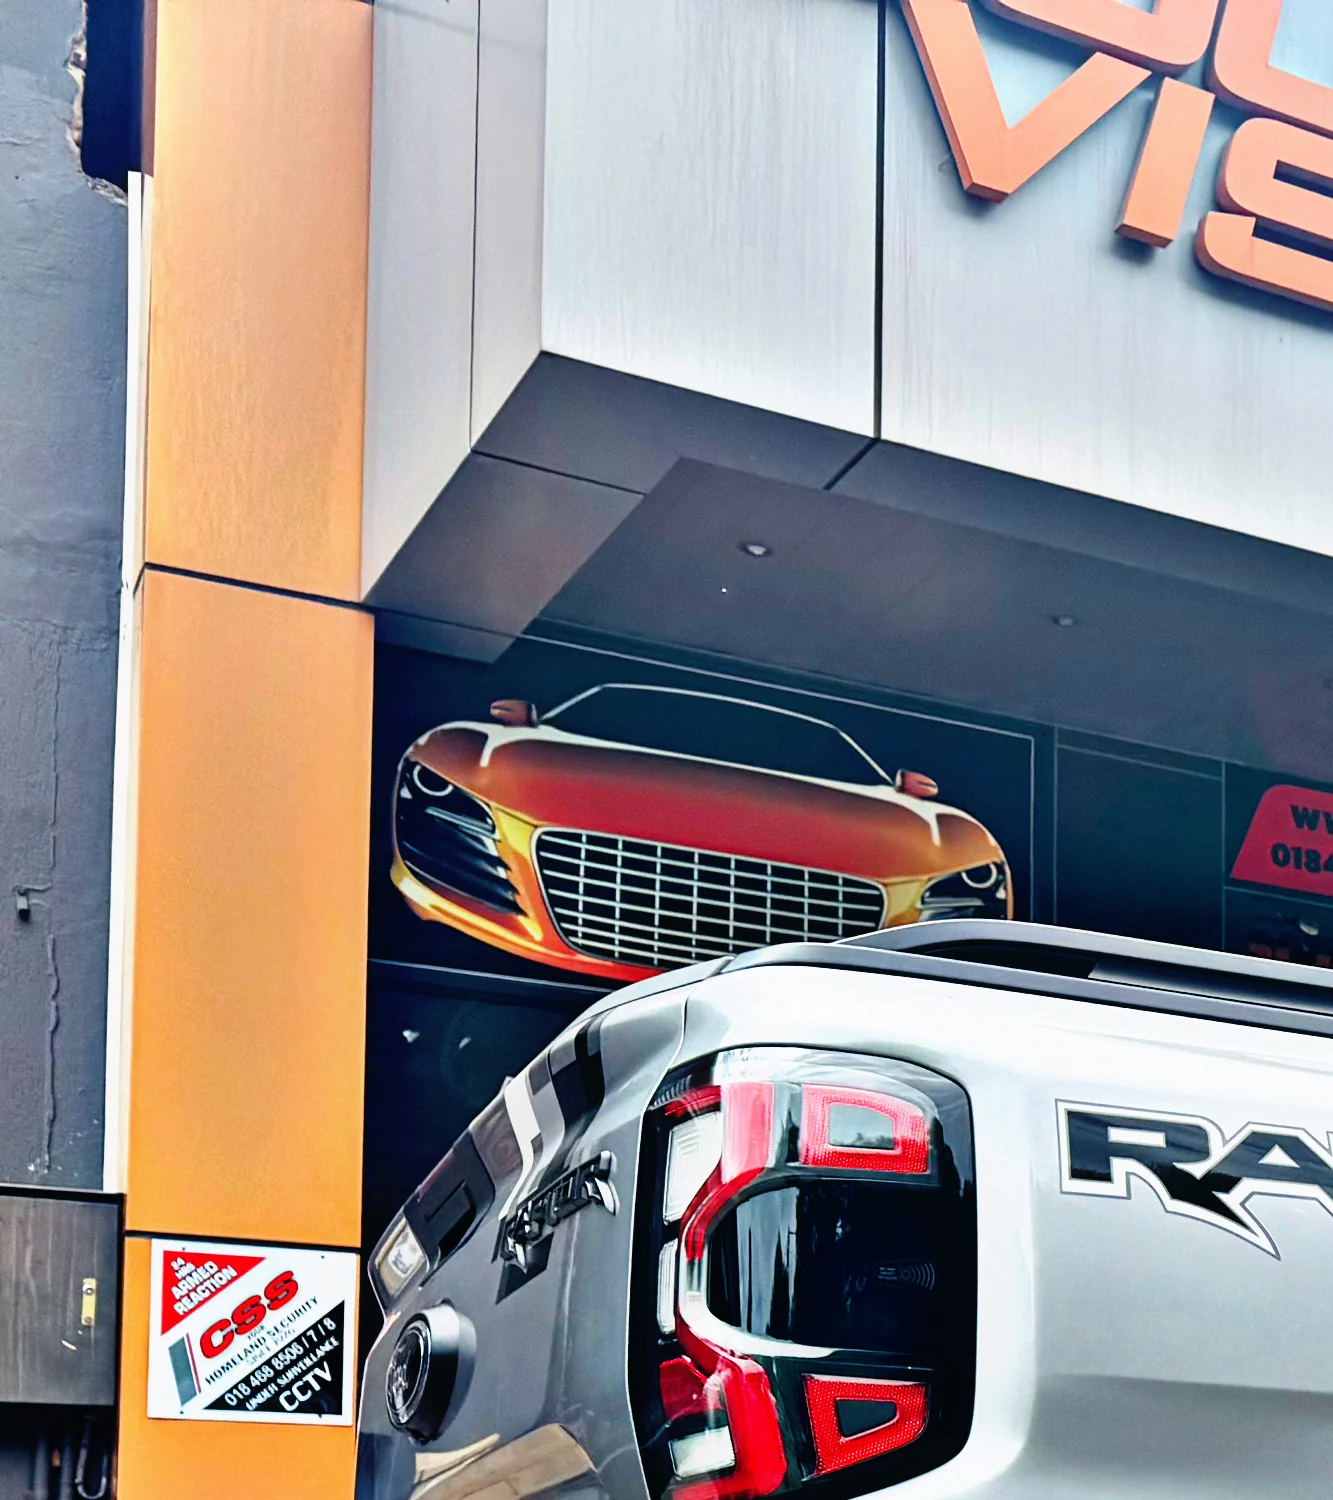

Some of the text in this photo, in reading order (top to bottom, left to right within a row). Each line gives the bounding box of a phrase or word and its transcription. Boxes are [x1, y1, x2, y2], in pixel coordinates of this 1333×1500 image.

[171, 1261, 219, 1300] ARMED
[173, 1265, 238, 1316] REACTION
[200, 1271, 298, 1359] CSS
[205, 1295, 318, 1385] HOMELAND SECURITY
[224, 1382, 252, 1407] 018
[279, 1360, 333, 1412] CCTV
